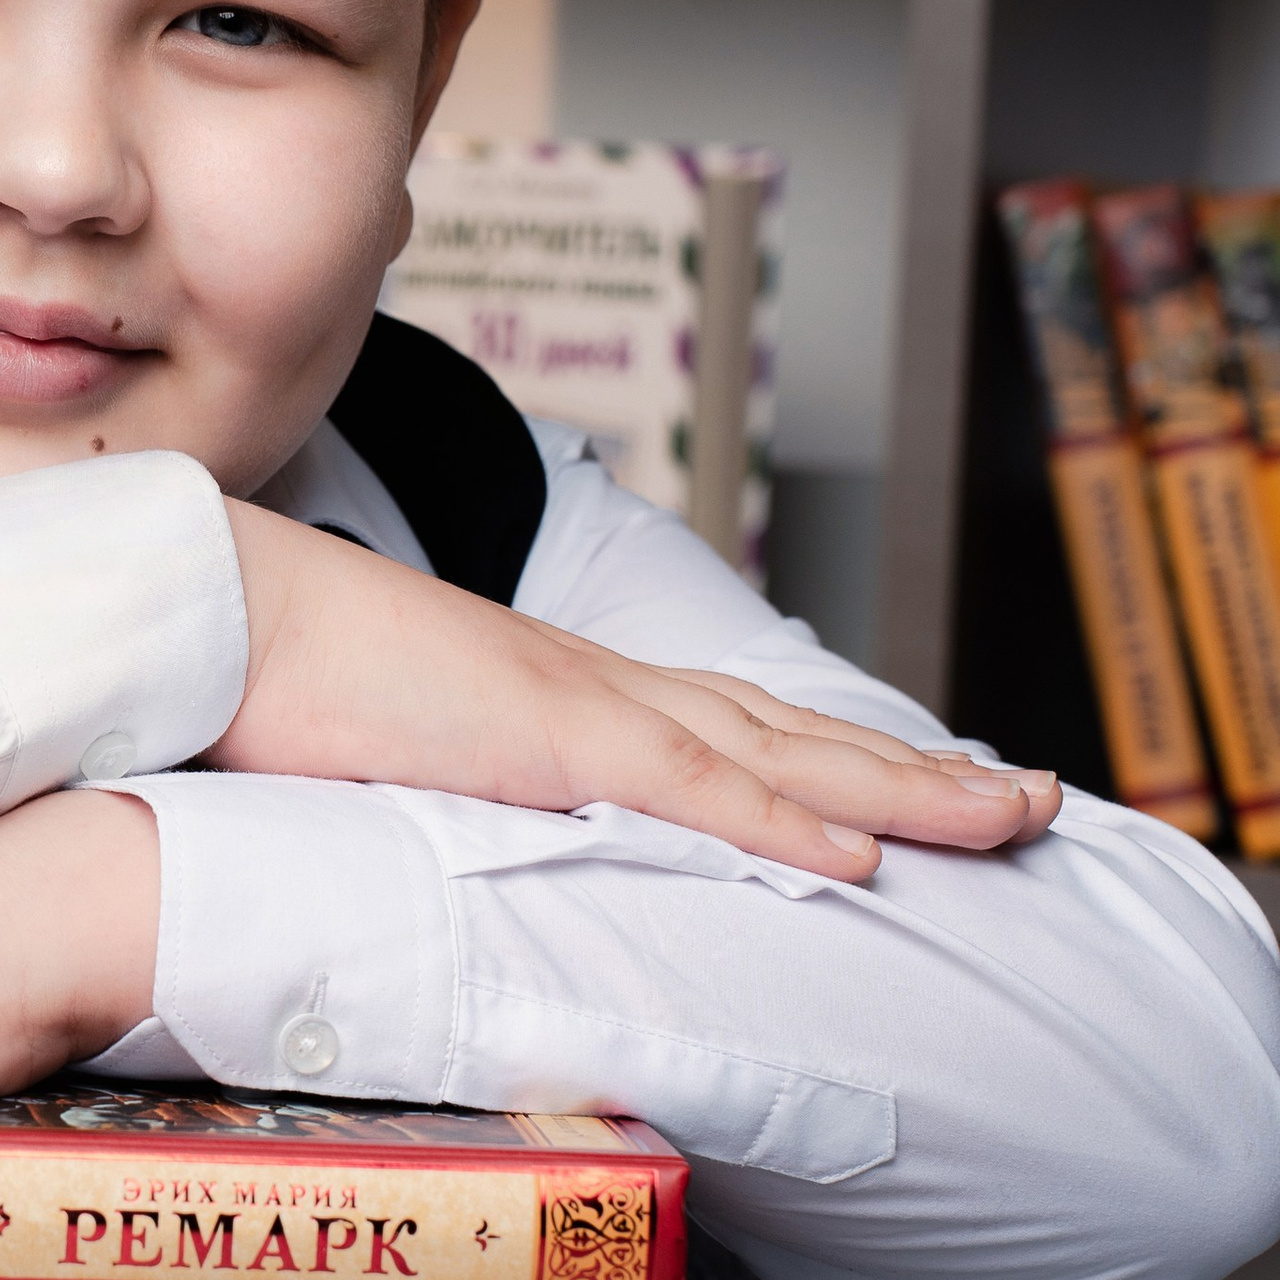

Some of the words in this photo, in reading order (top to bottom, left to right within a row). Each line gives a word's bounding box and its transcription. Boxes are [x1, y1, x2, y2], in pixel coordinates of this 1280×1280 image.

[122, 1177, 217, 1205] ЭРИХ
[232, 1180, 359, 1209] МАРИЯ
[58, 1207, 419, 1277] РЕМАРК
